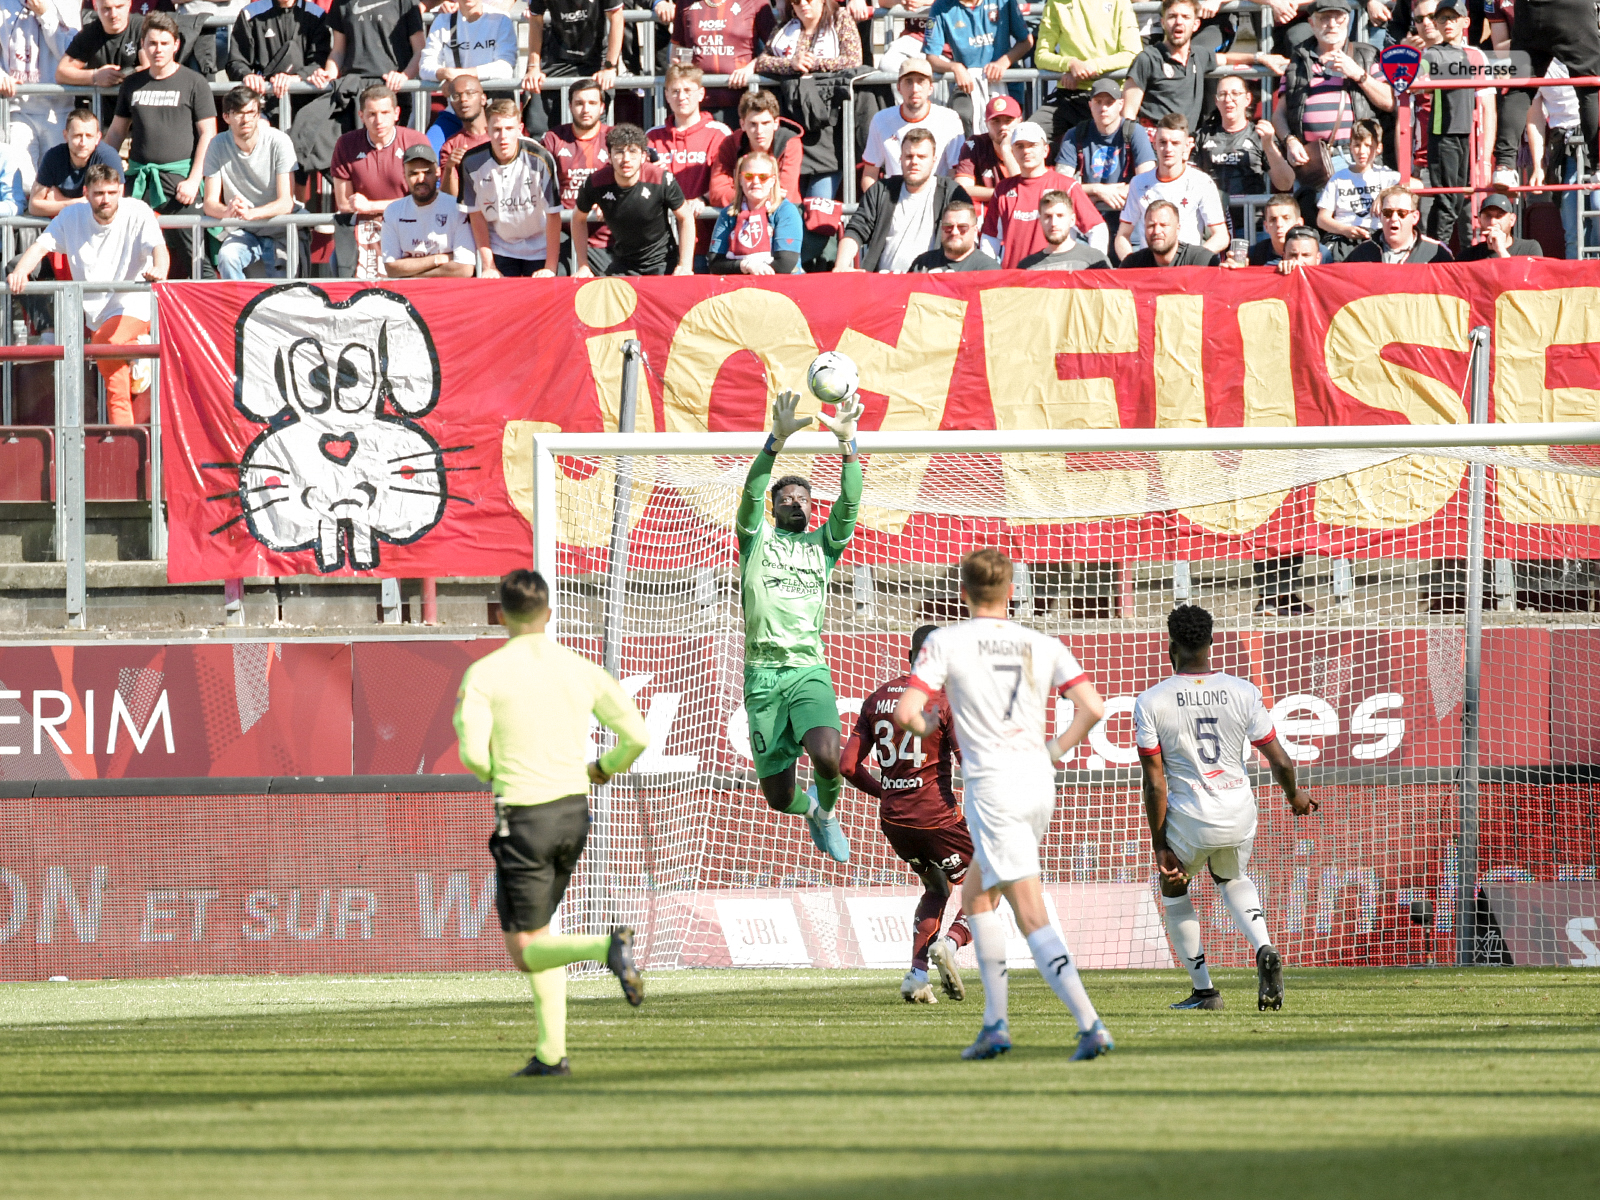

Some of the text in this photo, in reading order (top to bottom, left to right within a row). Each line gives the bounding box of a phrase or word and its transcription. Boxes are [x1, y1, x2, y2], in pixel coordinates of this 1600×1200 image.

[358, 14, 383, 22] AIR
[560, 9, 588, 20] MOSL
[698, 19, 727, 29] MOSL
[473, 39, 496, 50] AIR
[697, 34, 724, 46] CAR
[1211, 152, 1241, 163] MOSL
[1338, 184, 1382, 197] RAIDERS
[499, 194, 537, 207] SOLLAC
[993, 665, 1022, 721] 7
[875, 719, 928, 768] 34
[1195, 717, 1221, 764] 5
[141, 890, 220, 942] ET
[243, 889, 377, 942] SUR
